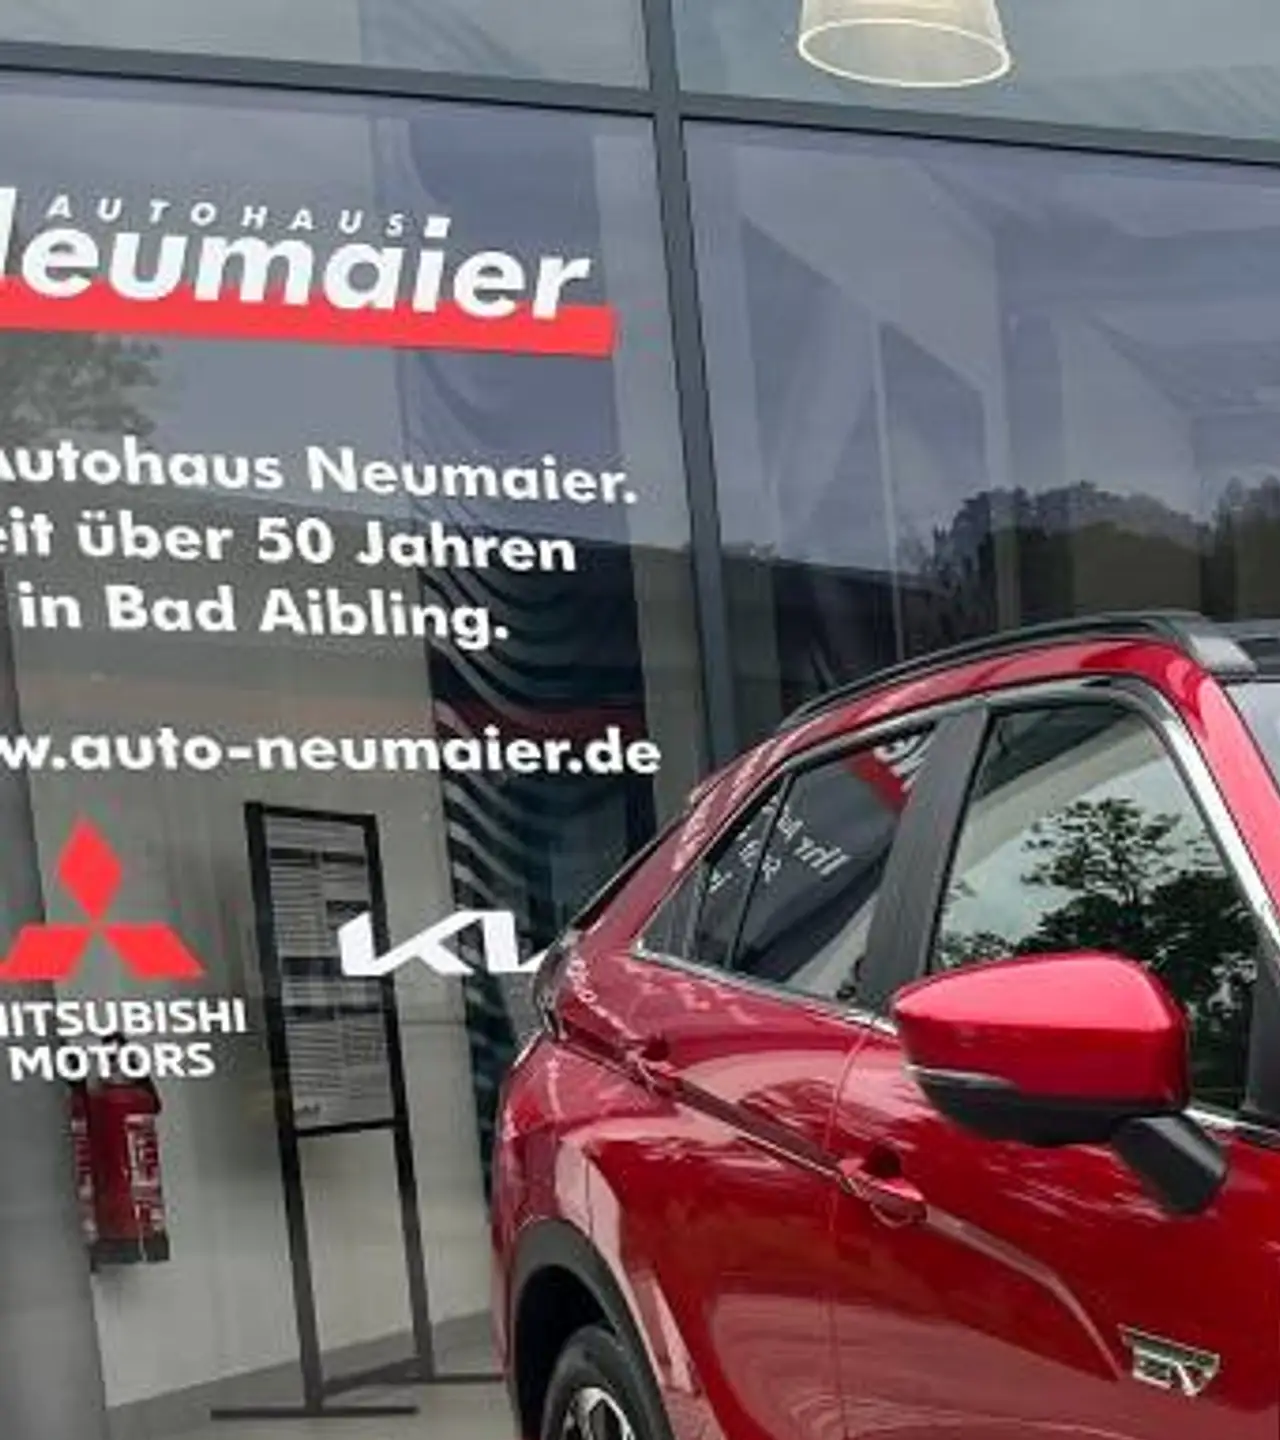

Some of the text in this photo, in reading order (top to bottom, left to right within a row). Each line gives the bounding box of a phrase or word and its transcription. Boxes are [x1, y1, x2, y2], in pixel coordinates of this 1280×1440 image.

[46, 194, 404, 239] AUTOHAUS
[306, 445, 637, 504] Neumaier.
[0, 506, 575, 571] it über 50 Jahren
[17, 581, 508, 650] in Bad Aibling.
[0, 725, 661, 773] w.auto-neumaier.de
[337, 910, 548, 976] KI
[0, 999, 246, 1037] ITSUBISHI
[8, 1042, 215, 1081] MOTORS
